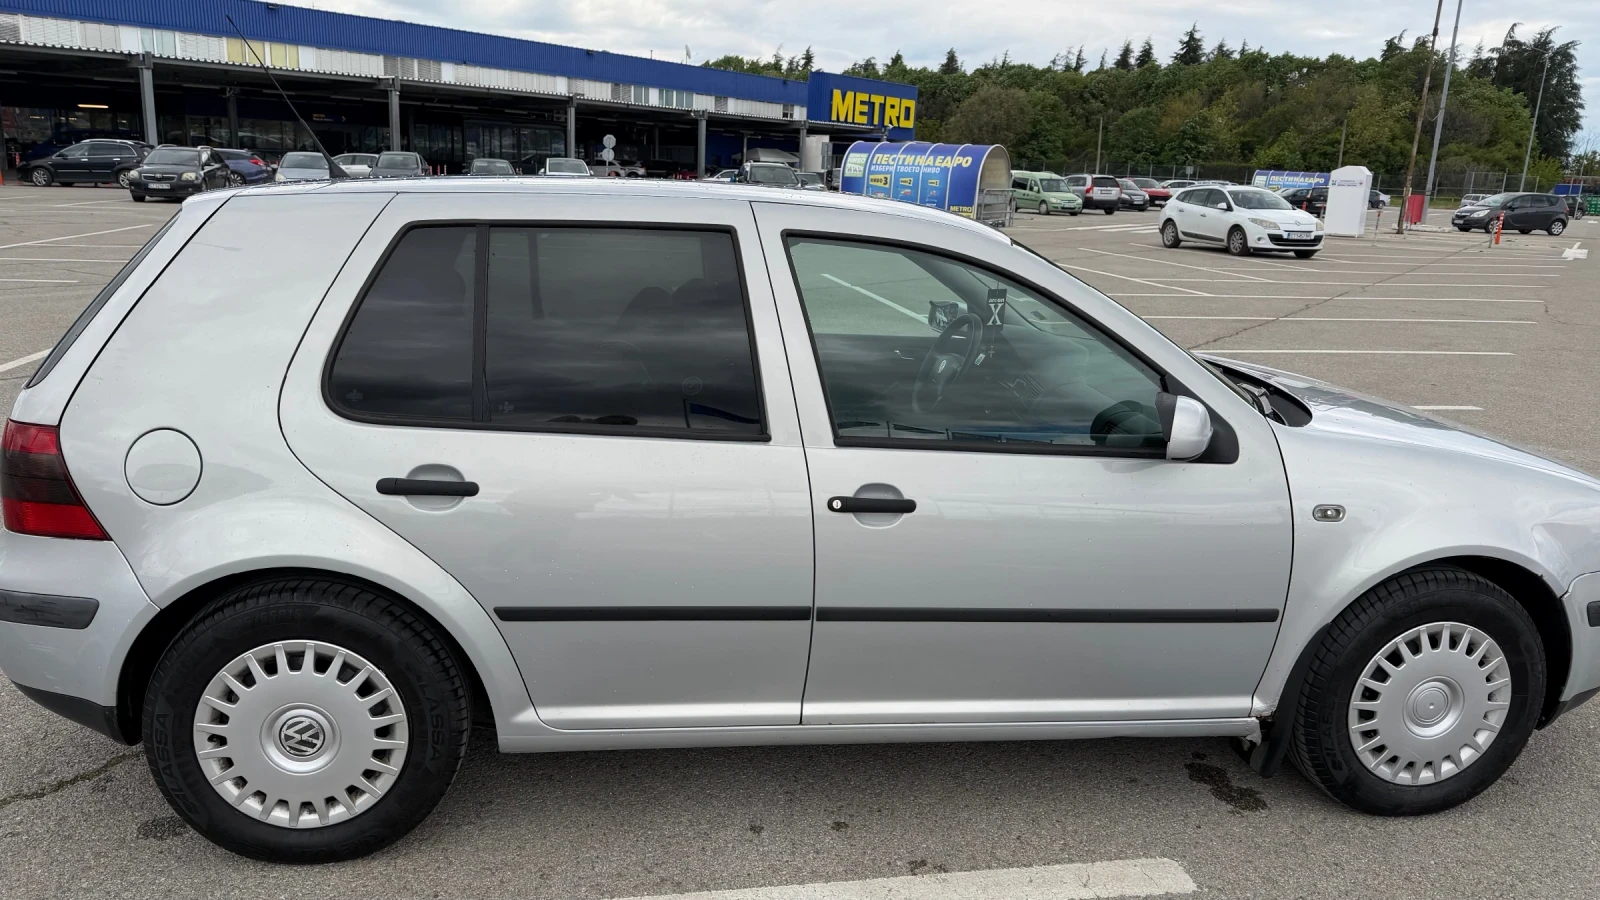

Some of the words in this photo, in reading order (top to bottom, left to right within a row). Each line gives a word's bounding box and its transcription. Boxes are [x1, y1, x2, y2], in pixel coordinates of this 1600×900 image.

[831, 88, 916, 129] METRO
[873, 154, 914, 165] ПЕСТИ
[914, 154, 935, 167] НА
[935, 155, 973, 168] ЕДРО
[870, 165, 894, 173] ИЗБЕРИ
[922, 166, 941, 174] НИВО
[883, 176, 888, 186] 3
[986, 304, 1004, 325] X
